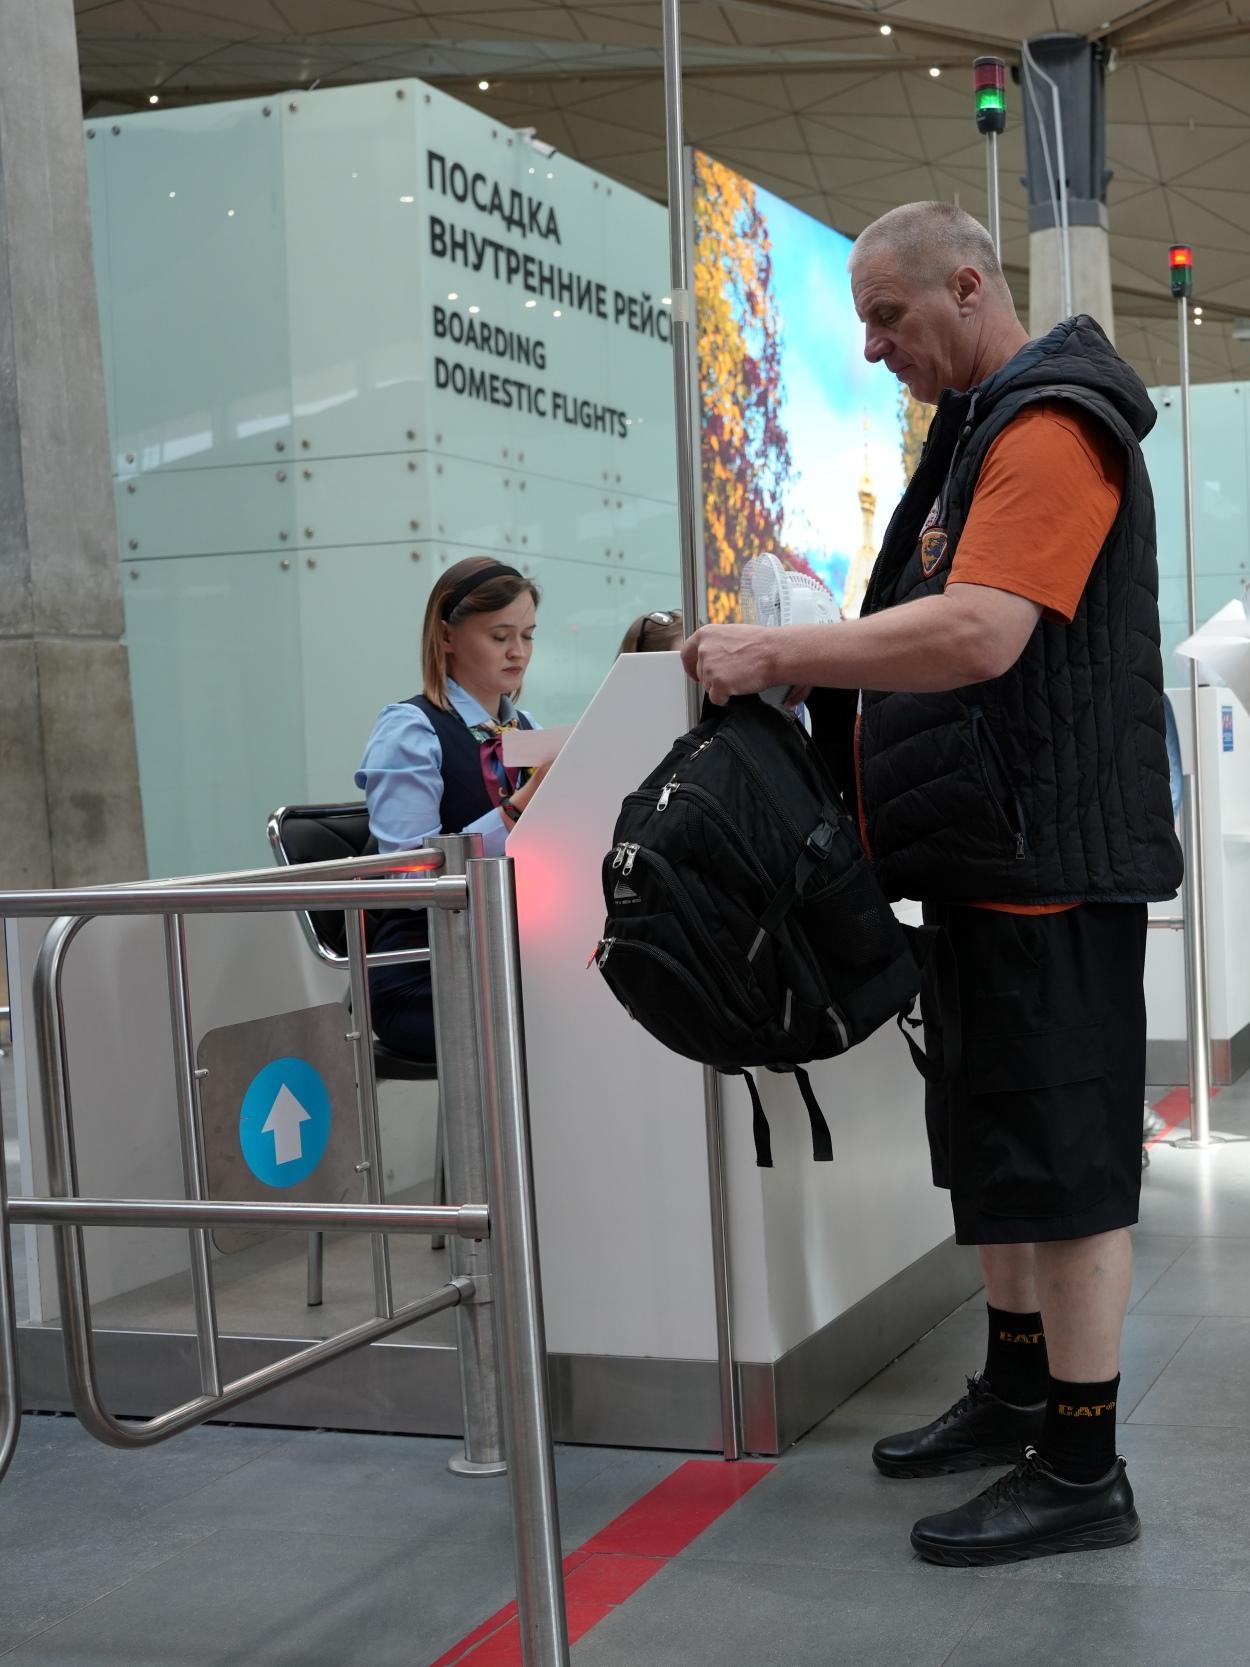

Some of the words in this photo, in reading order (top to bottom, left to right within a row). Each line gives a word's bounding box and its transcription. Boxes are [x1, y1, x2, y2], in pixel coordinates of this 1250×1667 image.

[427, 149, 562, 245] ПОСАДКА
[429, 214, 608, 320] ВНУТРЕННИЕ
[613, 290, 674, 346] РЕЙС
[433, 305, 546, 370] BOARDING
[434, 355, 547, 417] DOMESTIC
[551, 390, 628, 439] FLIGHTS
